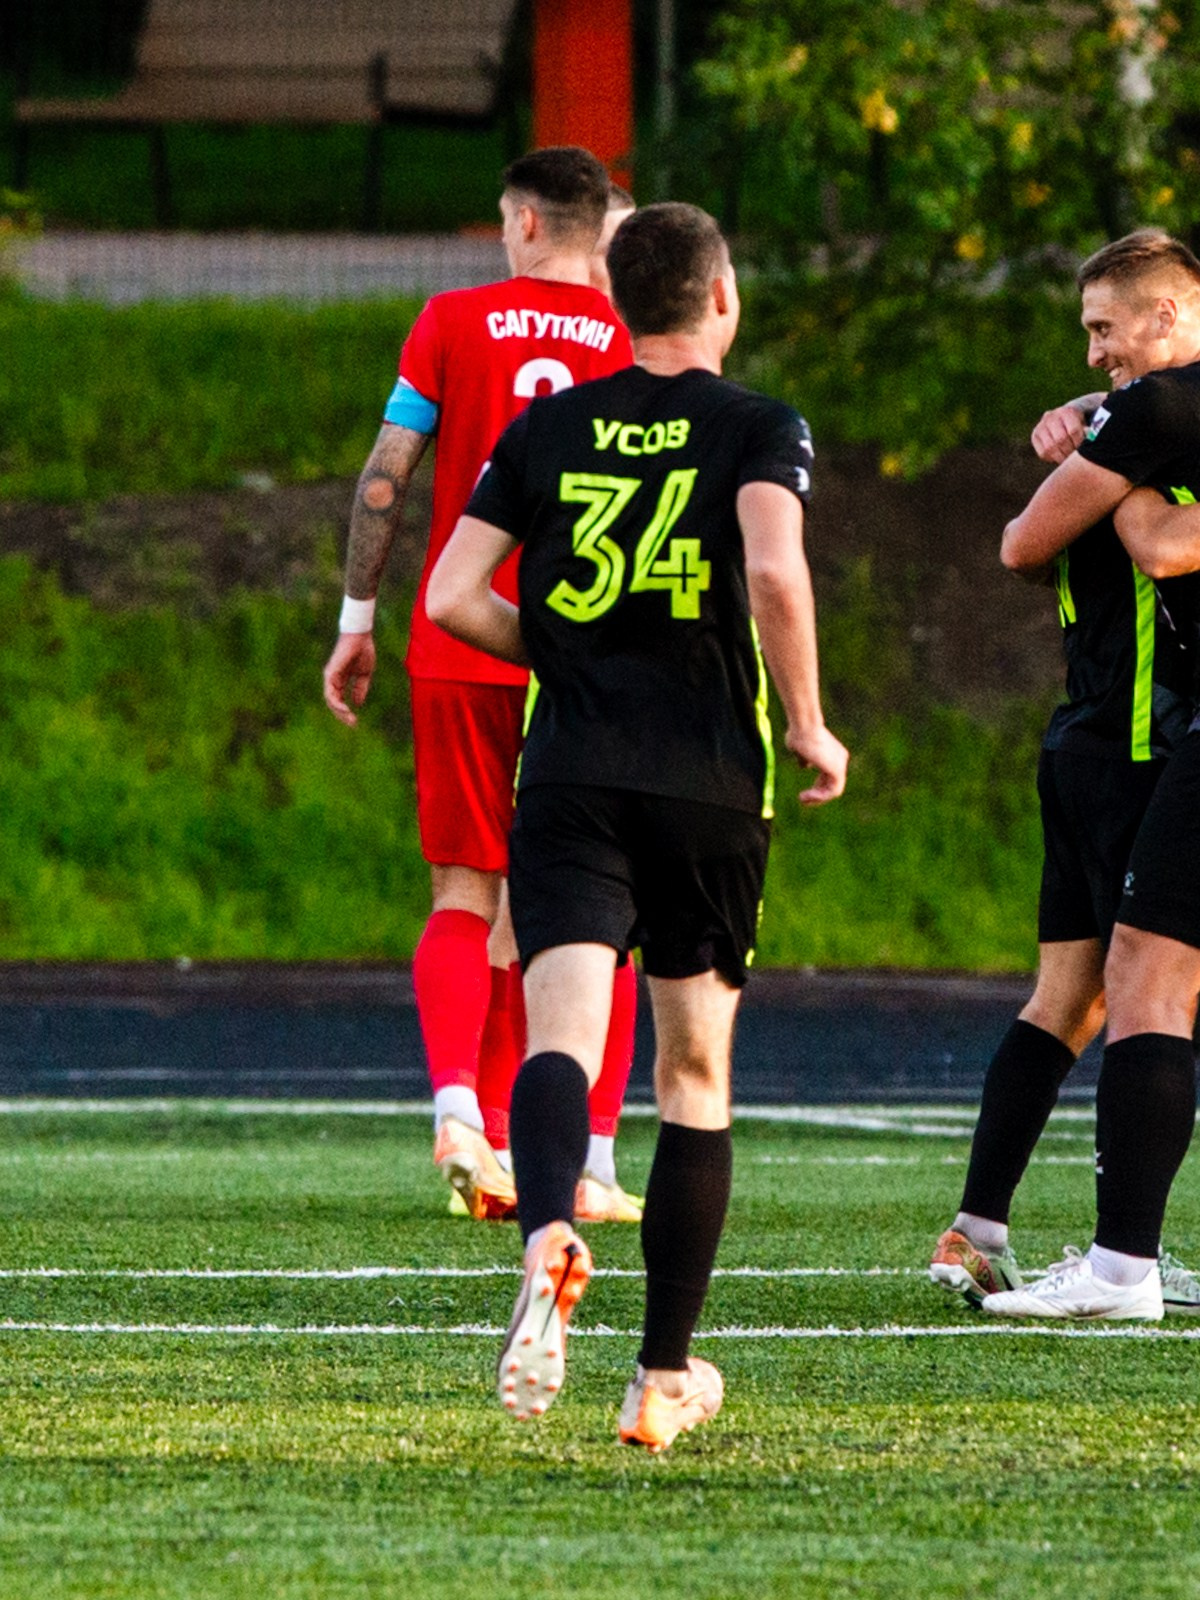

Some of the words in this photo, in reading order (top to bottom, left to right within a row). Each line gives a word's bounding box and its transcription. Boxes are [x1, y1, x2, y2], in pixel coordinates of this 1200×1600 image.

[486, 309, 615, 353] САГУТКИН
[592, 418, 691, 456] УСОВ
[545, 468, 711, 622] 34
